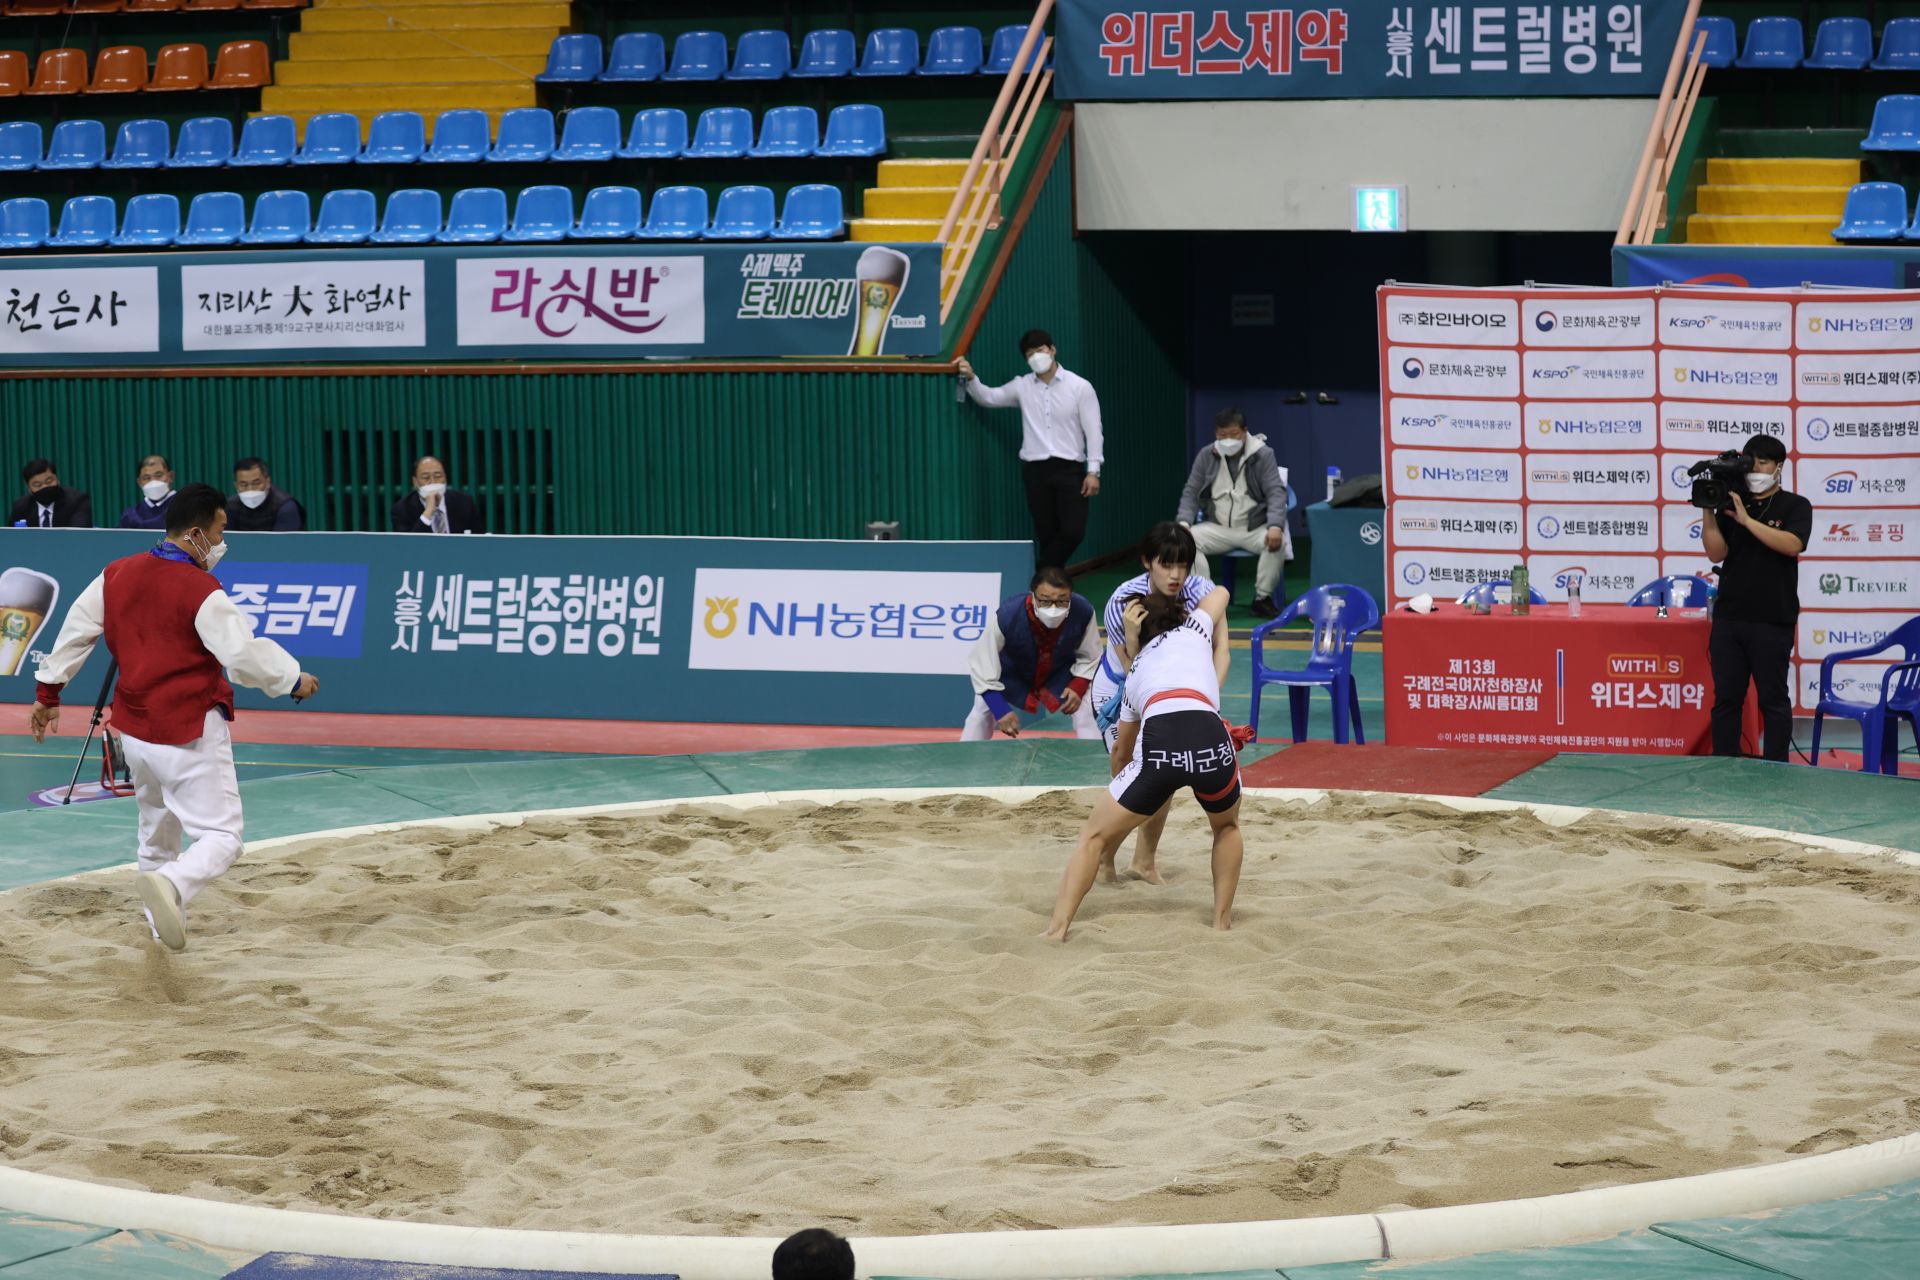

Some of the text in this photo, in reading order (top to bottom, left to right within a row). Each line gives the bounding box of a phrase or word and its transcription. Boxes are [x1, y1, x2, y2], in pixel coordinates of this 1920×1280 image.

[1100, 9, 1347, 77] 위더스제약
[1424, 5, 1643, 74] 센트럴병원
[198, 283, 412, 318] 지리산 大 화엄사
[737, 278, 857, 319] 트레비어!
[7, 288, 128, 333] 천은사
[1398, 311, 1507, 329] (주)화인바이오
[1561, 315, 1642, 329] 문화체육관광부
[1669, 316, 1706, 329] KSPO
[1824, 316, 1914, 332] NH농협은행
[1428, 362, 1508, 377] 문화체육관광부
[1532, 368, 1569, 379] KSPO
[1690, 369, 1778, 386] NH농협은행
[1843, 371, 1900, 386] 위더스제약
[1400, 416, 1437, 428] KSPO
[1554, 418, 1642, 434] NH농협은행
[1707, 418, 1764, 435] 위더스제약
[1832, 420, 1919, 437] 센트럴종합병원
[1422, 466, 1509, 483] NH농협은행
[1572, 470, 1630, 485] 위더스제약
[1825, 479, 1907, 494] SBI 저축은행
[1440, 518, 1497, 534] 위더스제약
[1562, 520, 1649, 536] 센트럴종합병원
[1588, 575, 1635, 590] 저축은행
[1843, 576, 1907, 593] TREVIER
[427, 573, 665, 657] 센트럴종합병원
[748, 602, 987, 641] NH농협은행
[1449, 658, 1496, 675] 제13회
[1407, 693, 1421, 709] 및
[1590, 681, 1705, 710] 위더스제약
[1148, 741, 1236, 774] 구례군청
